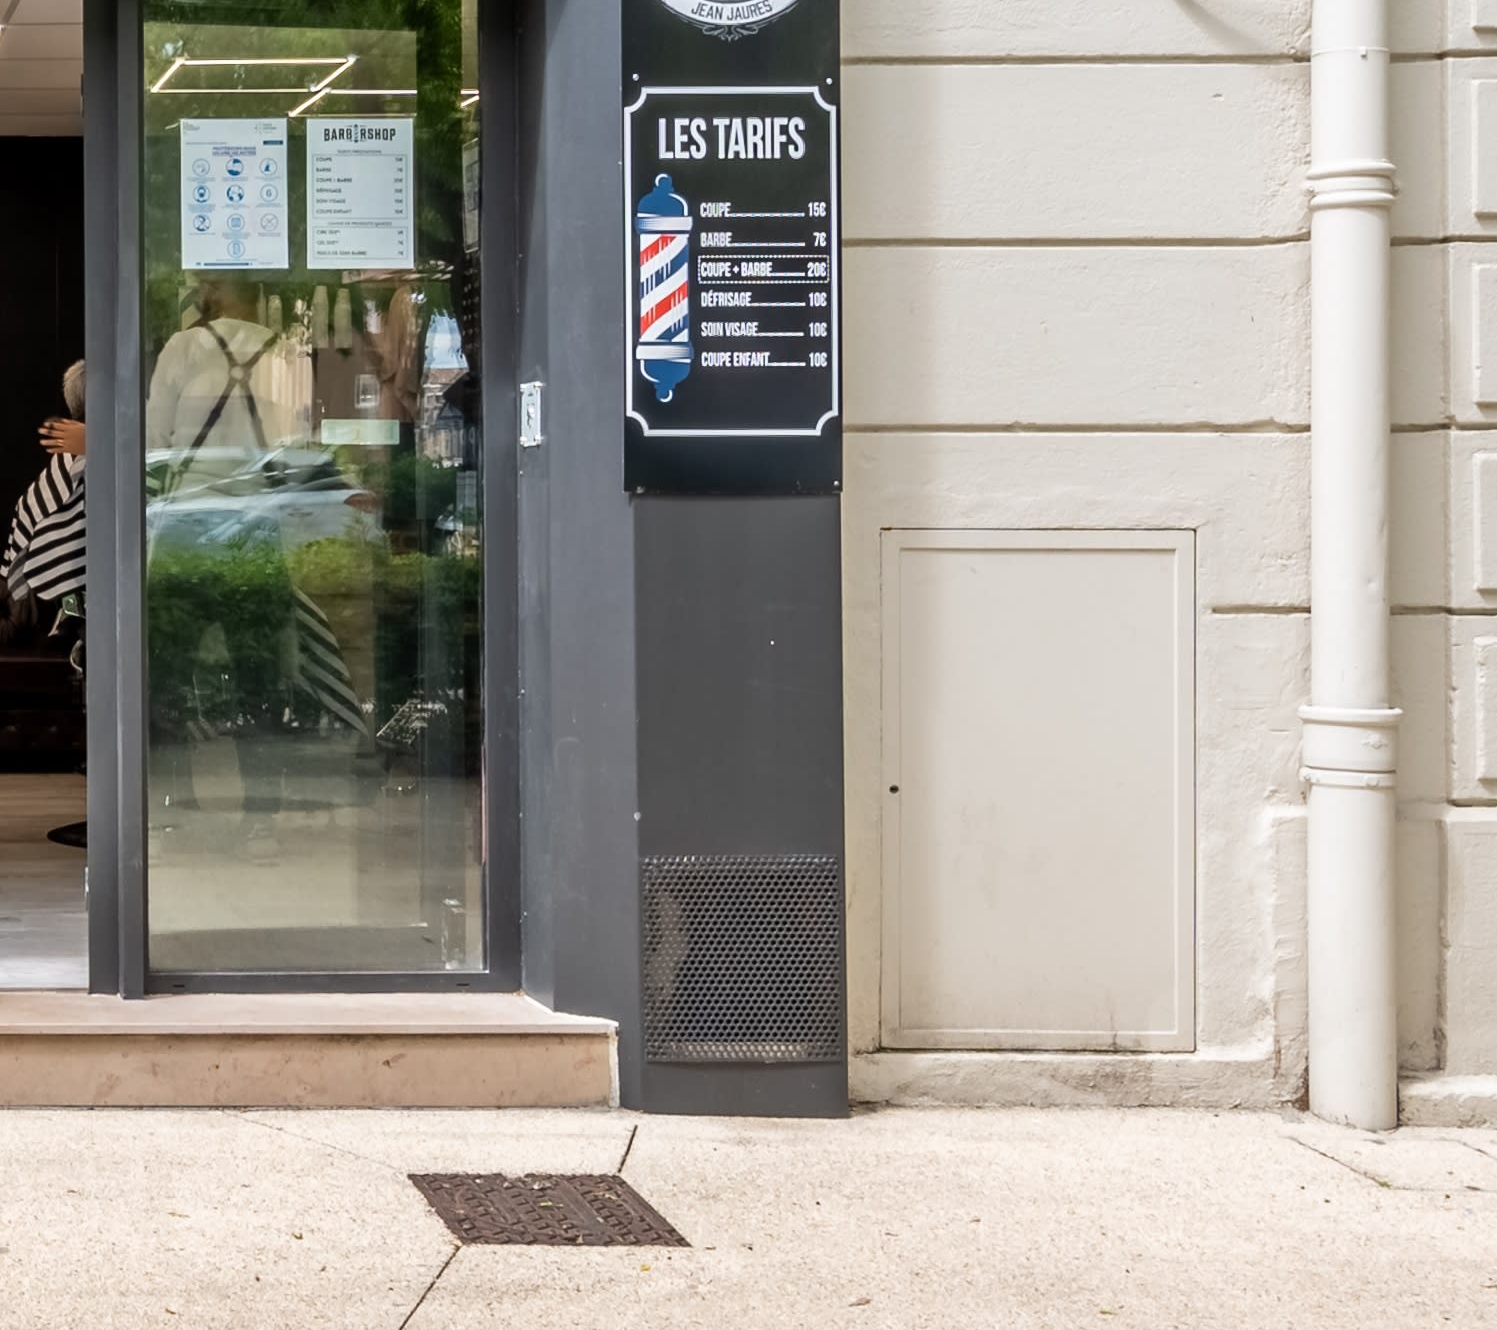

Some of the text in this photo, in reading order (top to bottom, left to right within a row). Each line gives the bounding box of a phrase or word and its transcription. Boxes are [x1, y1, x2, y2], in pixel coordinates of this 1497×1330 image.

[691, 0, 773, 21] JEAN JAURES
[658, 116, 807, 160] LES TARIFS
[700, 202, 731, 217] COUPE
[700, 232, 732, 247] BARBE
[700, 262, 731, 277] COUPE
[740, 262, 772, 277] BARBE
[701, 289, 751, 307] DÉFRISAGE
[701, 322, 723, 337] SOIN
[724, 322, 758, 337] VISAGE
[701, 352, 732, 367] COUPE
[733, 352, 770, 367] ENFANT
